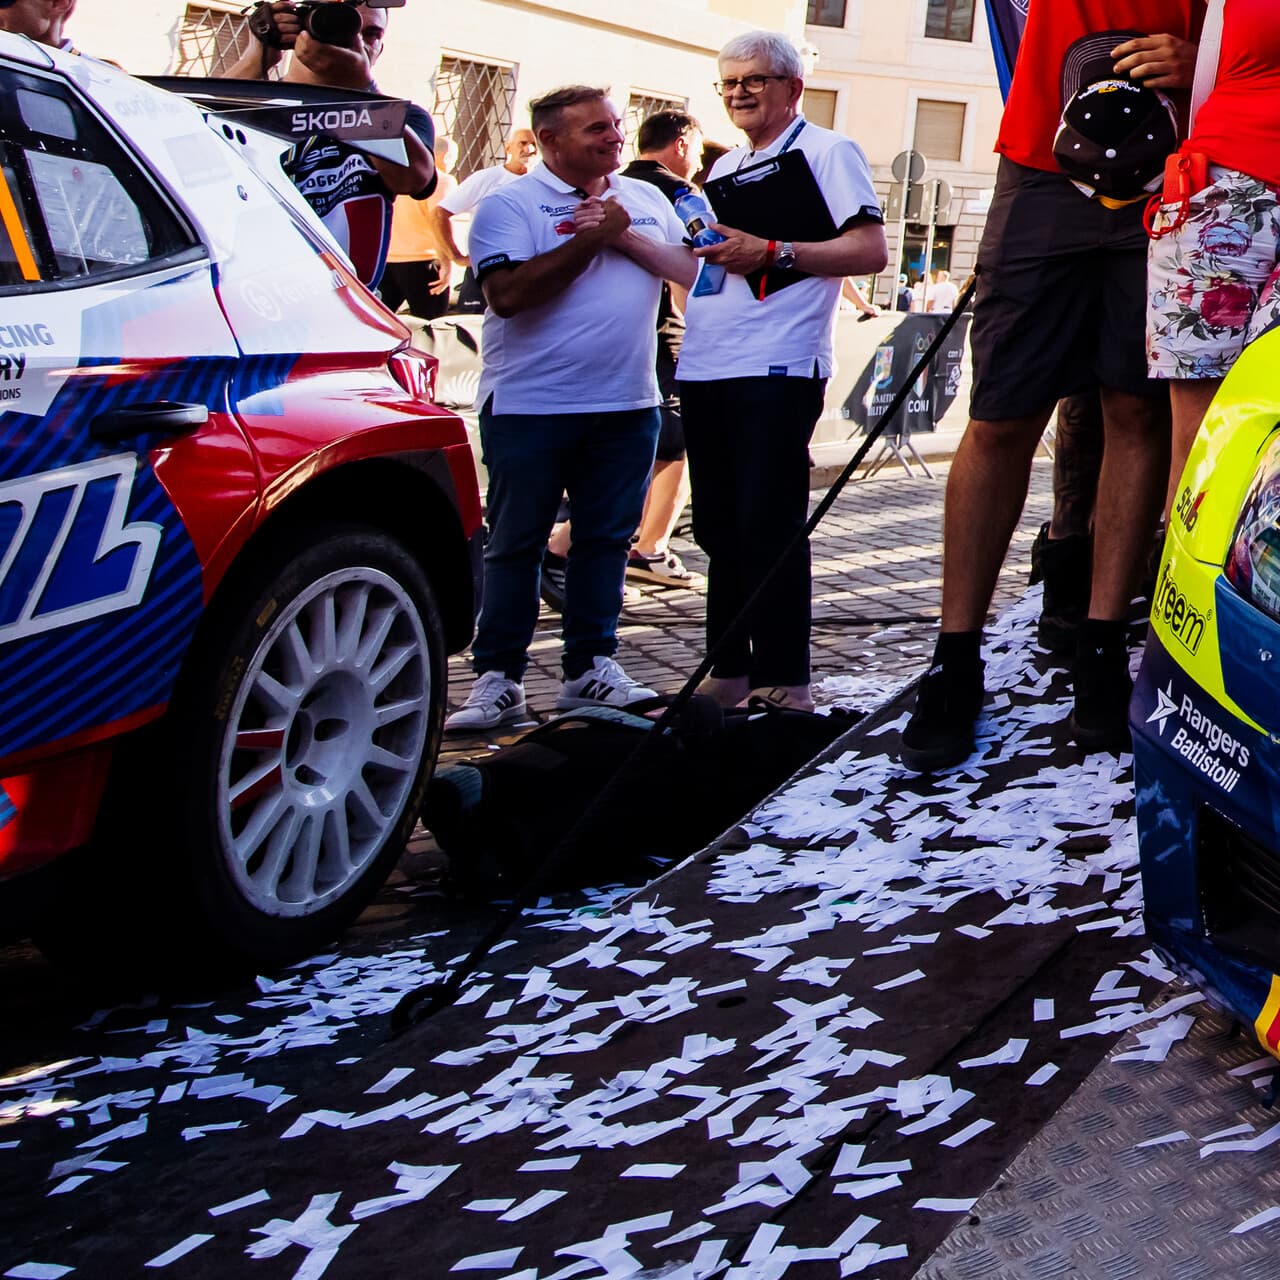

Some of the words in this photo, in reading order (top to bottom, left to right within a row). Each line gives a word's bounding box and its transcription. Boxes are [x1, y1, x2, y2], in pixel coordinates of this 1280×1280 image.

[907, 400, 929, 413] CONI
[1154, 562, 1208, 656] freem
[1171, 726, 1241, 794] Battistolli
[1178, 693, 1251, 768] Rangers
